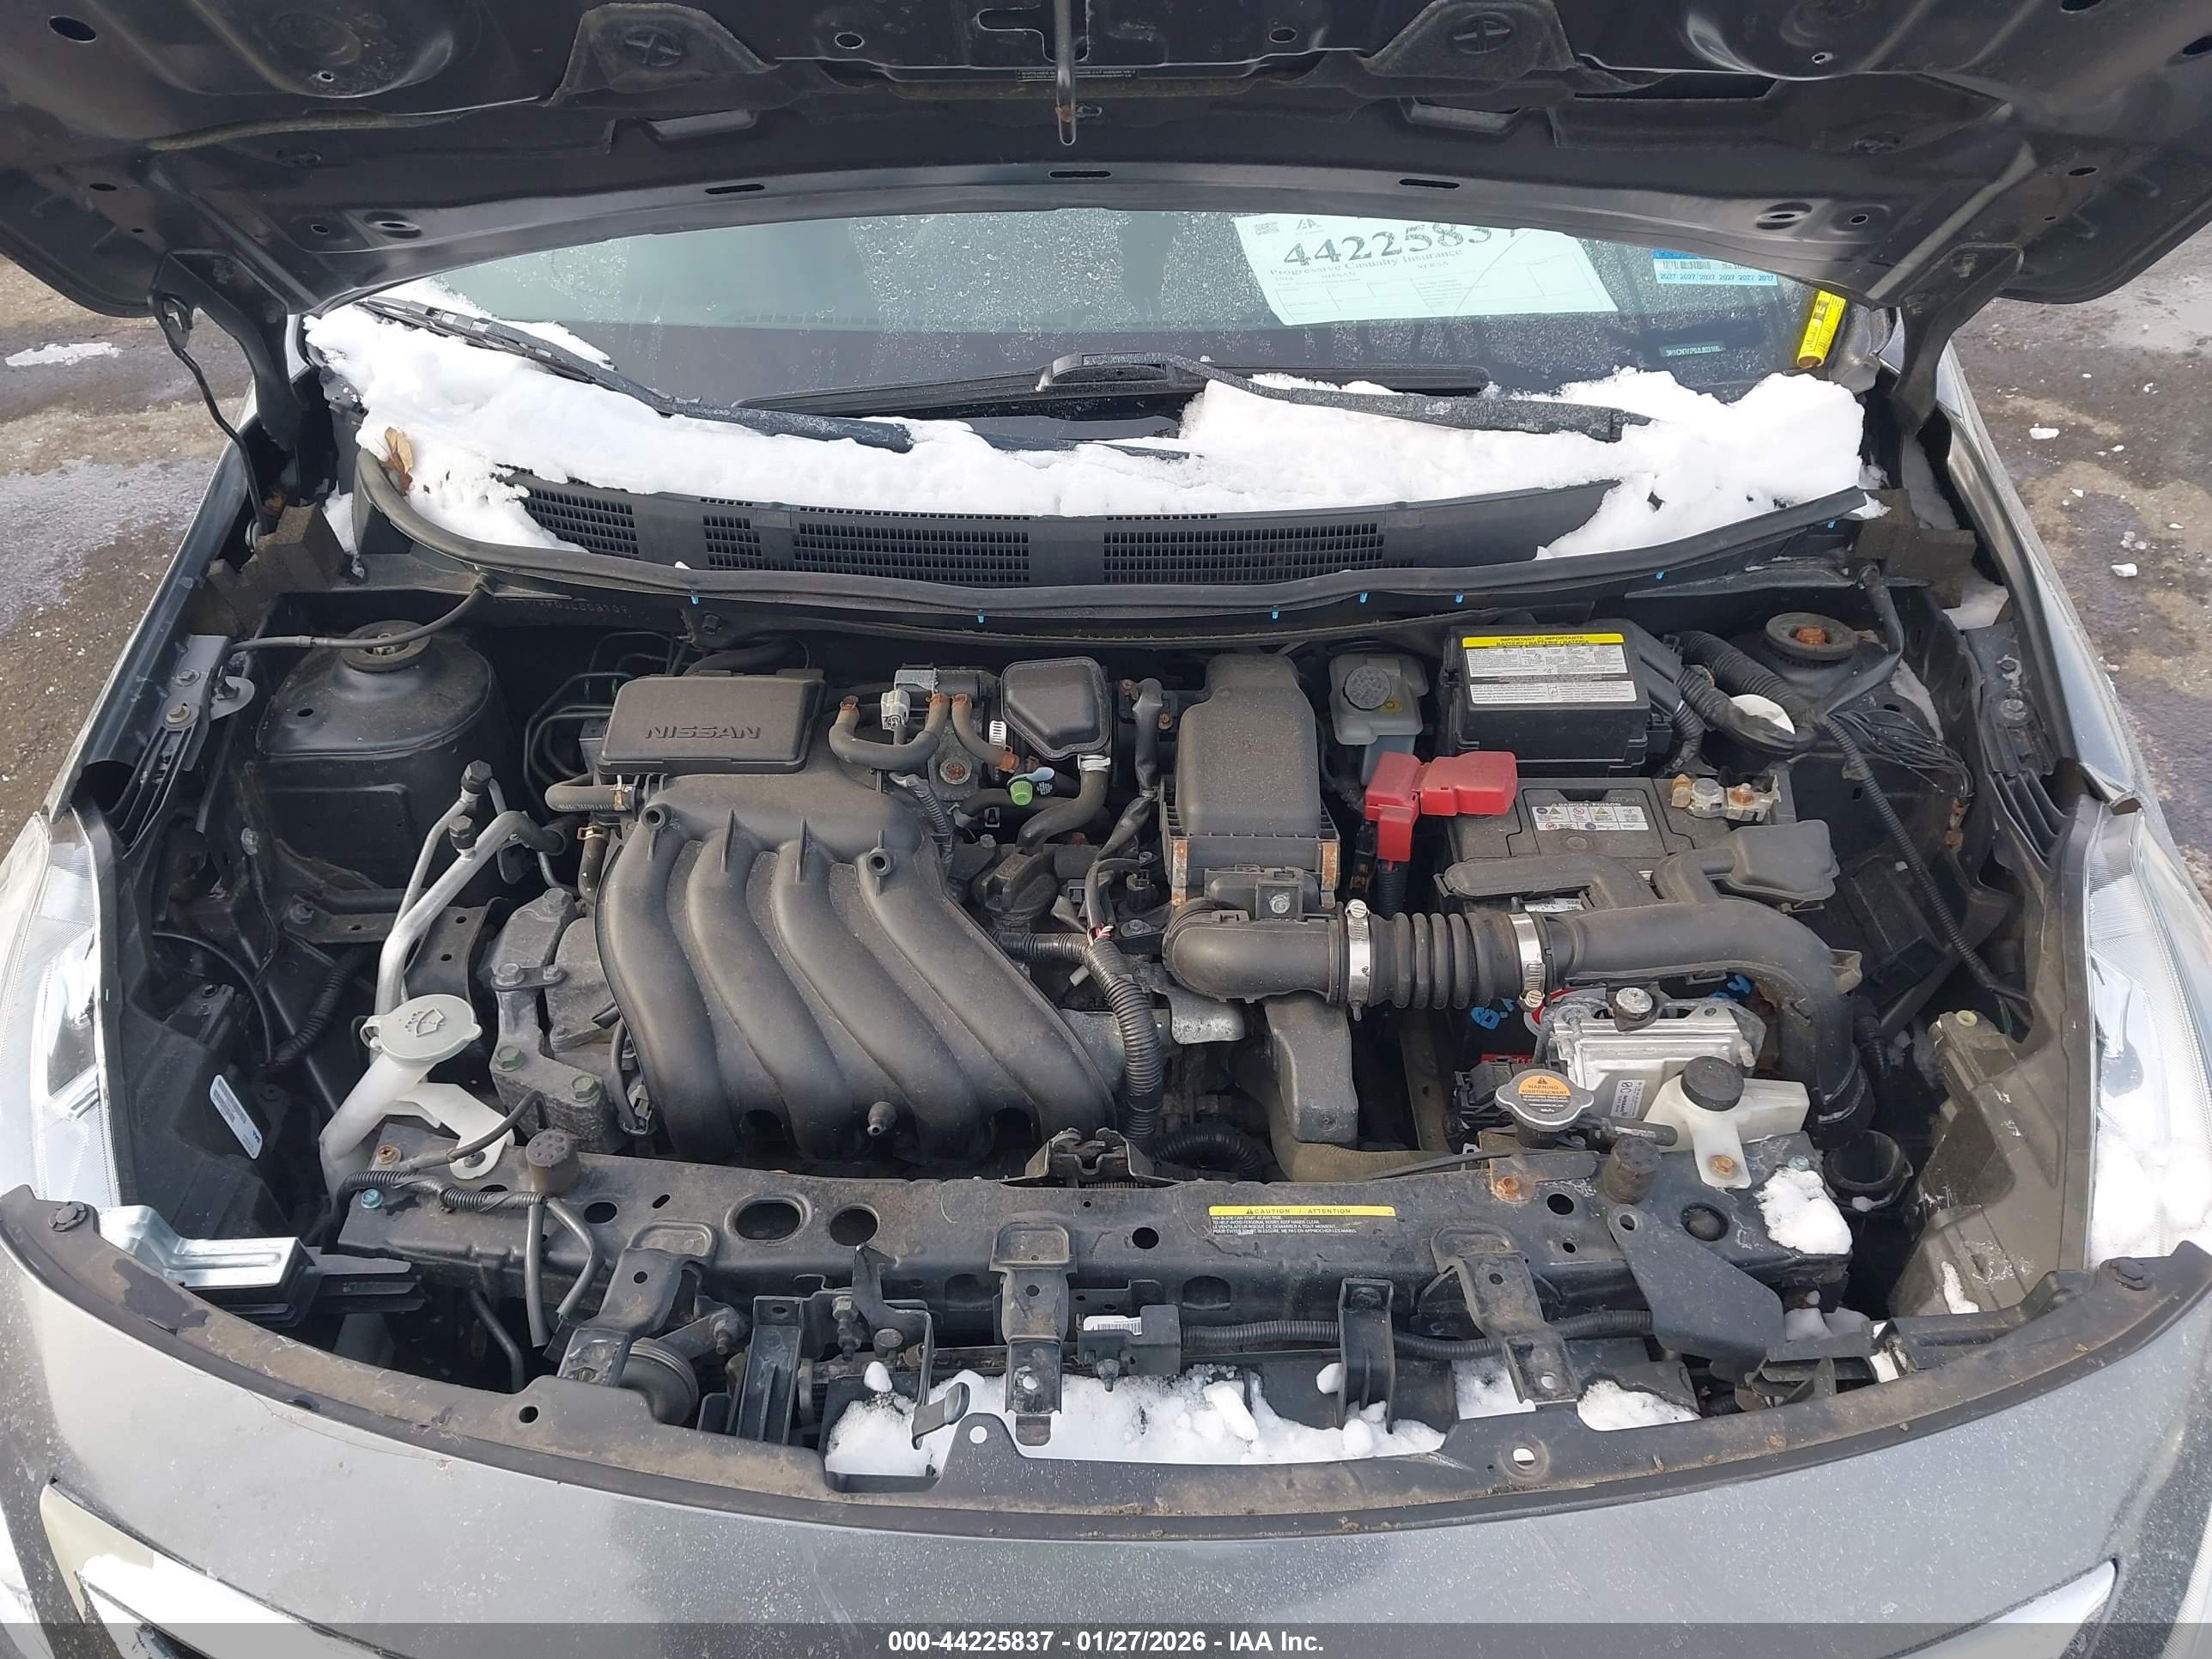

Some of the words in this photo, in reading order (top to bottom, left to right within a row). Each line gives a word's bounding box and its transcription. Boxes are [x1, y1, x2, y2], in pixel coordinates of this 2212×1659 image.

[1270, 263, 1341, 276] Progressive
[1345, 256, 1399, 270] Casualty
[1402, 249, 1463, 264] Insurance
[645, 726, 762, 739] NISSAN
